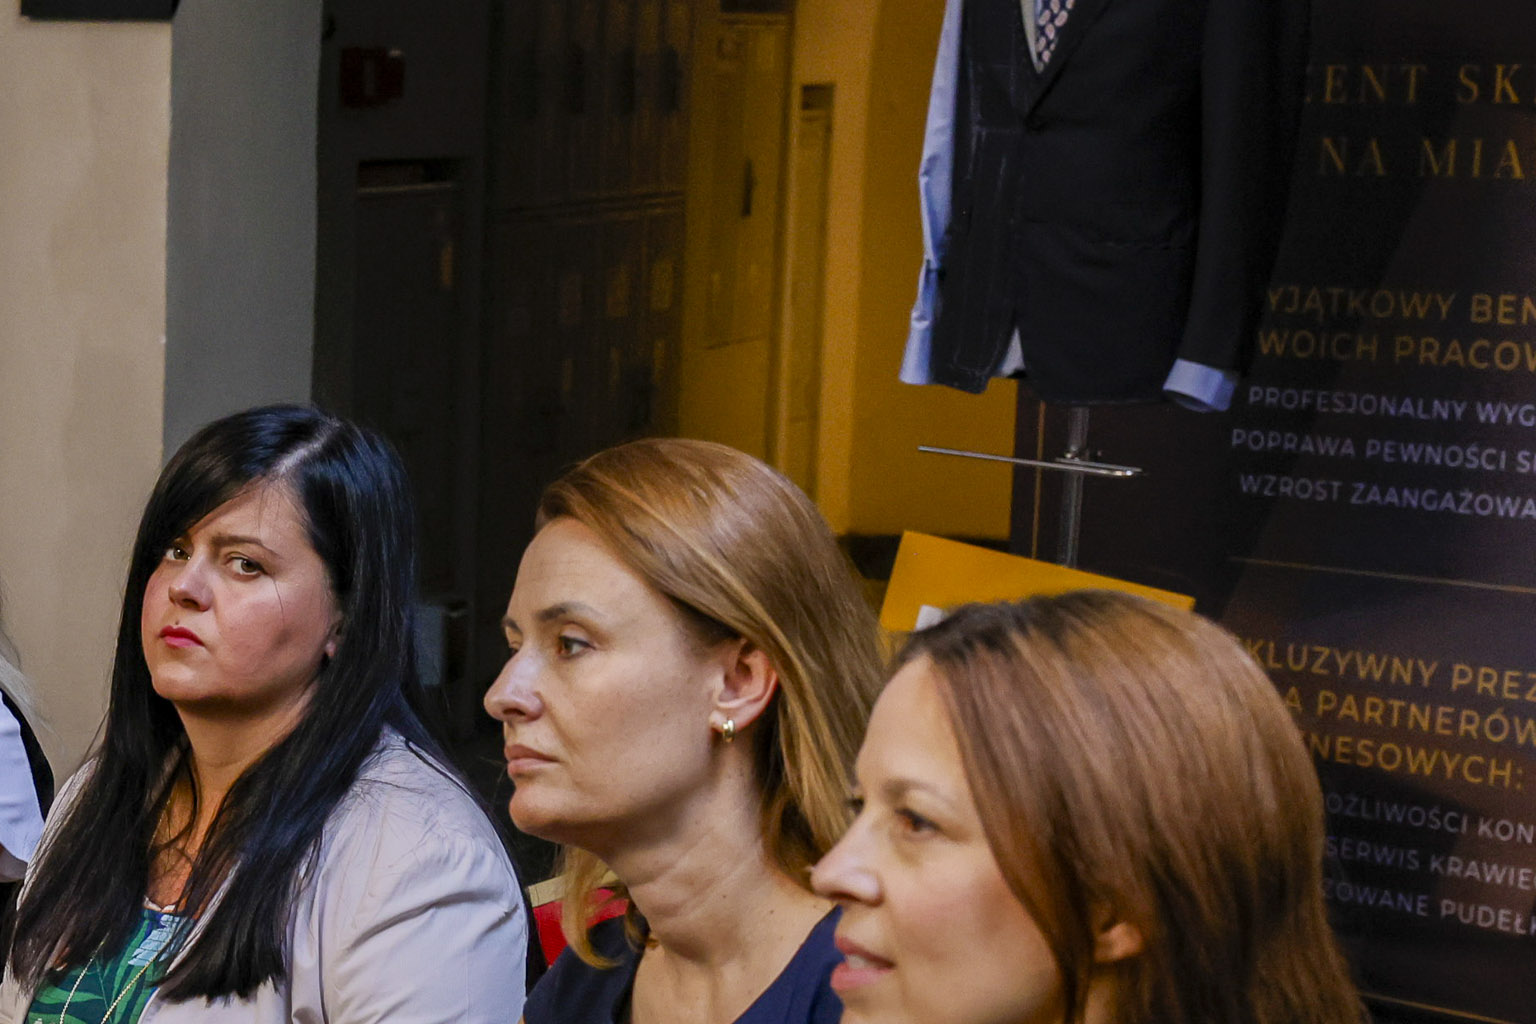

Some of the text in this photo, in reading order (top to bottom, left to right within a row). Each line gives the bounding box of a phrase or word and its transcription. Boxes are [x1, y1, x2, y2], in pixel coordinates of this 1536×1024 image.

[1306, 63, 1536, 104] ENT SK
[1319, 136, 1525, 179] NA MIA
[1248, 385, 1536, 427] PROFESJONALNY WYG
[1231, 428, 1356, 457] POPRAWA
[1365, 439, 1507, 471] PEWNOŚCI
[1240, 473, 1536, 519] WZROST ZAANGAŻOWA
[1316, 690, 1536, 746] PARTNERÓW
[1308, 732, 1524, 789] NESOWYCH:
[1478, 815, 1535, 845] KON
[1326, 835, 1536, 892] SERWIS KRAWIE
